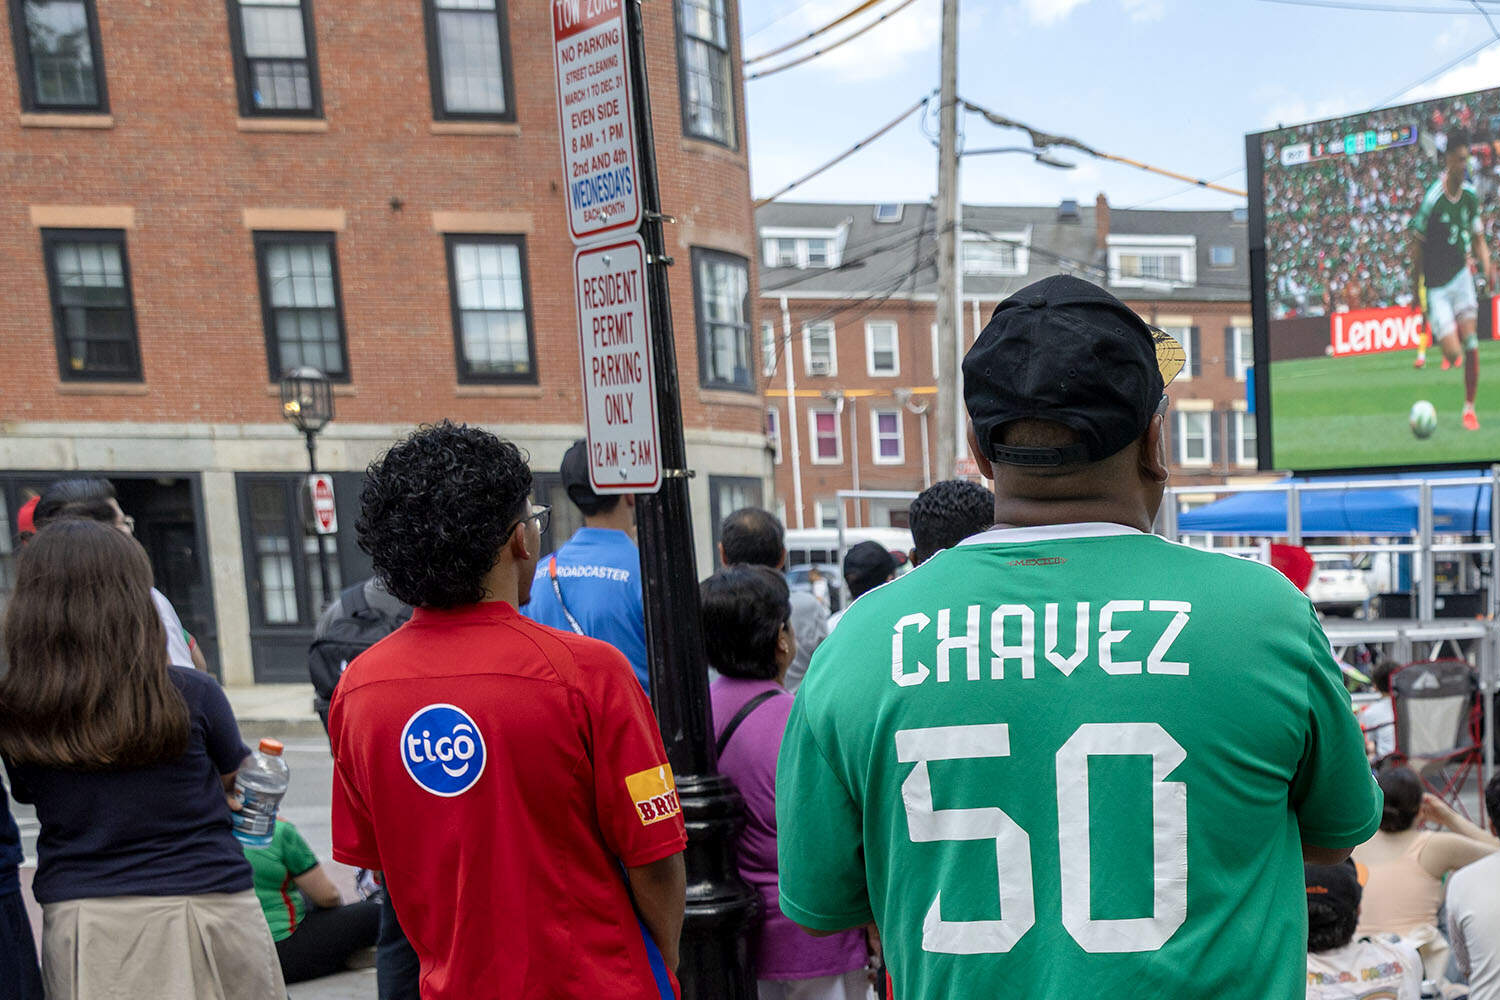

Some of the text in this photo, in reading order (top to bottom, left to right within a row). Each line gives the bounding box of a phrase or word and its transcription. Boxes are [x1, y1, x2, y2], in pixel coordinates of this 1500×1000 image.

[561, 28, 619, 65] NO PARKING
[565, 54, 619, 86] STREET CLEANING
[565, 75, 623, 106] MARCH 1 TO DEC. 31
[571, 98, 620, 130] EVEN SIDE
[572, 137, 578, 153] 8
[580, 132, 594, 151] AM
[602, 128, 607, 144] 1
[609, 122, 624, 142] PM
[572, 148, 628, 178] 2nd AND 4th
[572, 166, 633, 210] WEDNESDAYS
[602, 200, 626, 217] MONTH
[583, 269, 637, 310] RESIDENT
[592, 311, 633, 348] PERMIT
[1334, 313, 1424, 354] Lenovo
[592, 351, 642, 387] PARKING
[605, 392, 634, 426] ONLY
[593, 442, 603, 467] 12
[606, 442, 619, 467] AM
[630, 440, 637, 466] 5
[638, 440, 652, 466] AM
[556, 565, 630, 582] ROADCASTER
[892, 599, 1193, 687] CHAVEZ
[407, 729, 475, 763] tigo
[895, 722, 1188, 954] 50
